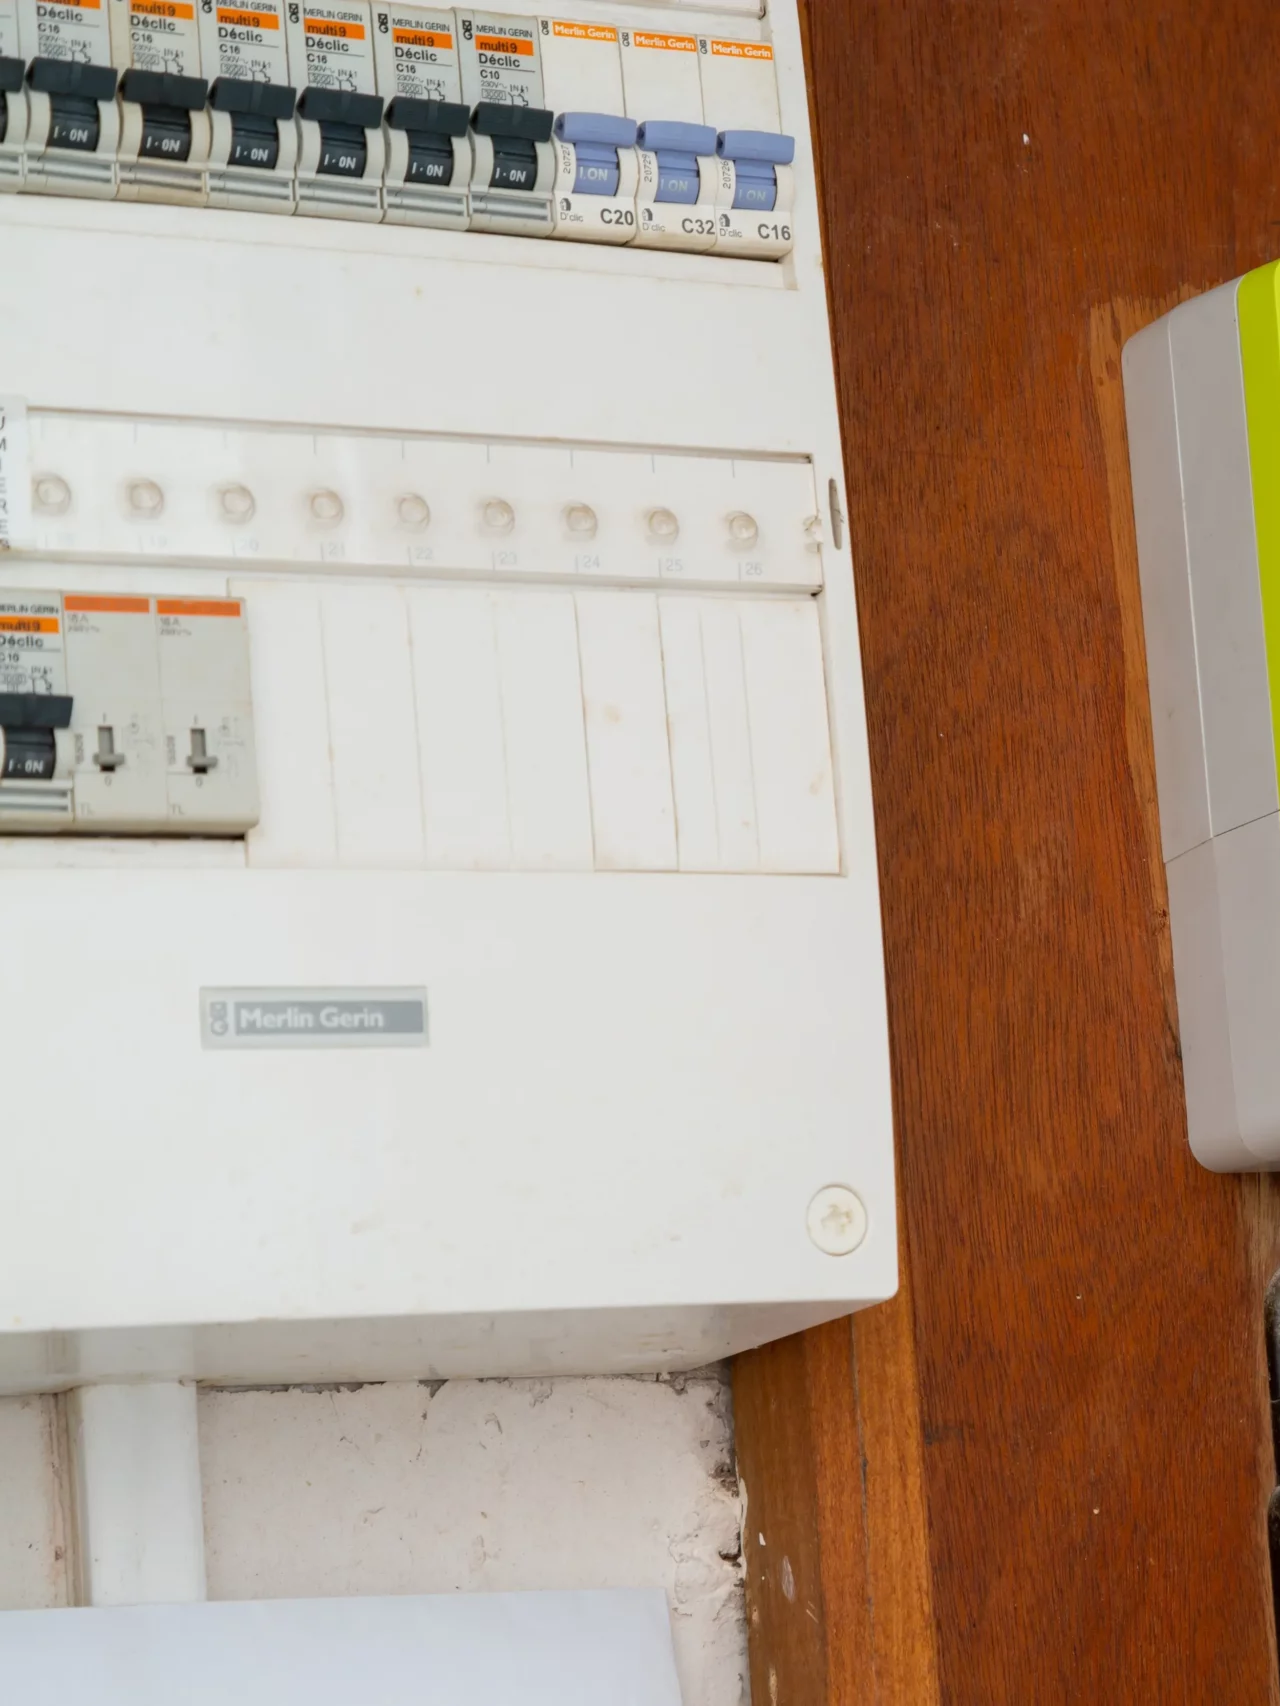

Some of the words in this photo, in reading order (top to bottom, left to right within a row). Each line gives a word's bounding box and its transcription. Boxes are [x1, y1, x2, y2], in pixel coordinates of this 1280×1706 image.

[37, 6, 83, 22] Déclic
[250, 2, 277, 12] GERIN
[303, 8, 335, 18] MERLIN
[337, 11, 362, 22] GERIN
[130, 15, 175, 31] Déclic
[392, 18, 423, 29] MERLIN
[425, 21, 450, 32] GERIN
[218, 27, 263, 43] Déclic
[476, 25, 506, 35] MERLIN
[508, 28, 532, 38] GERIN
[555, 25, 586, 36] Merlin
[587, 27, 615, 39] Gerin
[306, 36, 349, 52] Déclic
[635, 35, 666, 48] Merlin
[668, 38, 695, 50] Gerin
[395, 47, 437, 62] Déclic
[713, 43, 742, 55] Merlin
[744, 47, 771, 58] Gerin
[478, 53, 520, 68] Déclic
[600, 208, 634, 226] C20
[682, 218, 715, 235] C32
[758, 223, 791, 241] C16
[583, 555, 600, 569] 24
[666, 558, 683, 572] 25
[745, 562, 763, 576] 26
[240, 1007, 314, 1029] Merlin
[320, 1006, 384, 1028] Gerin
